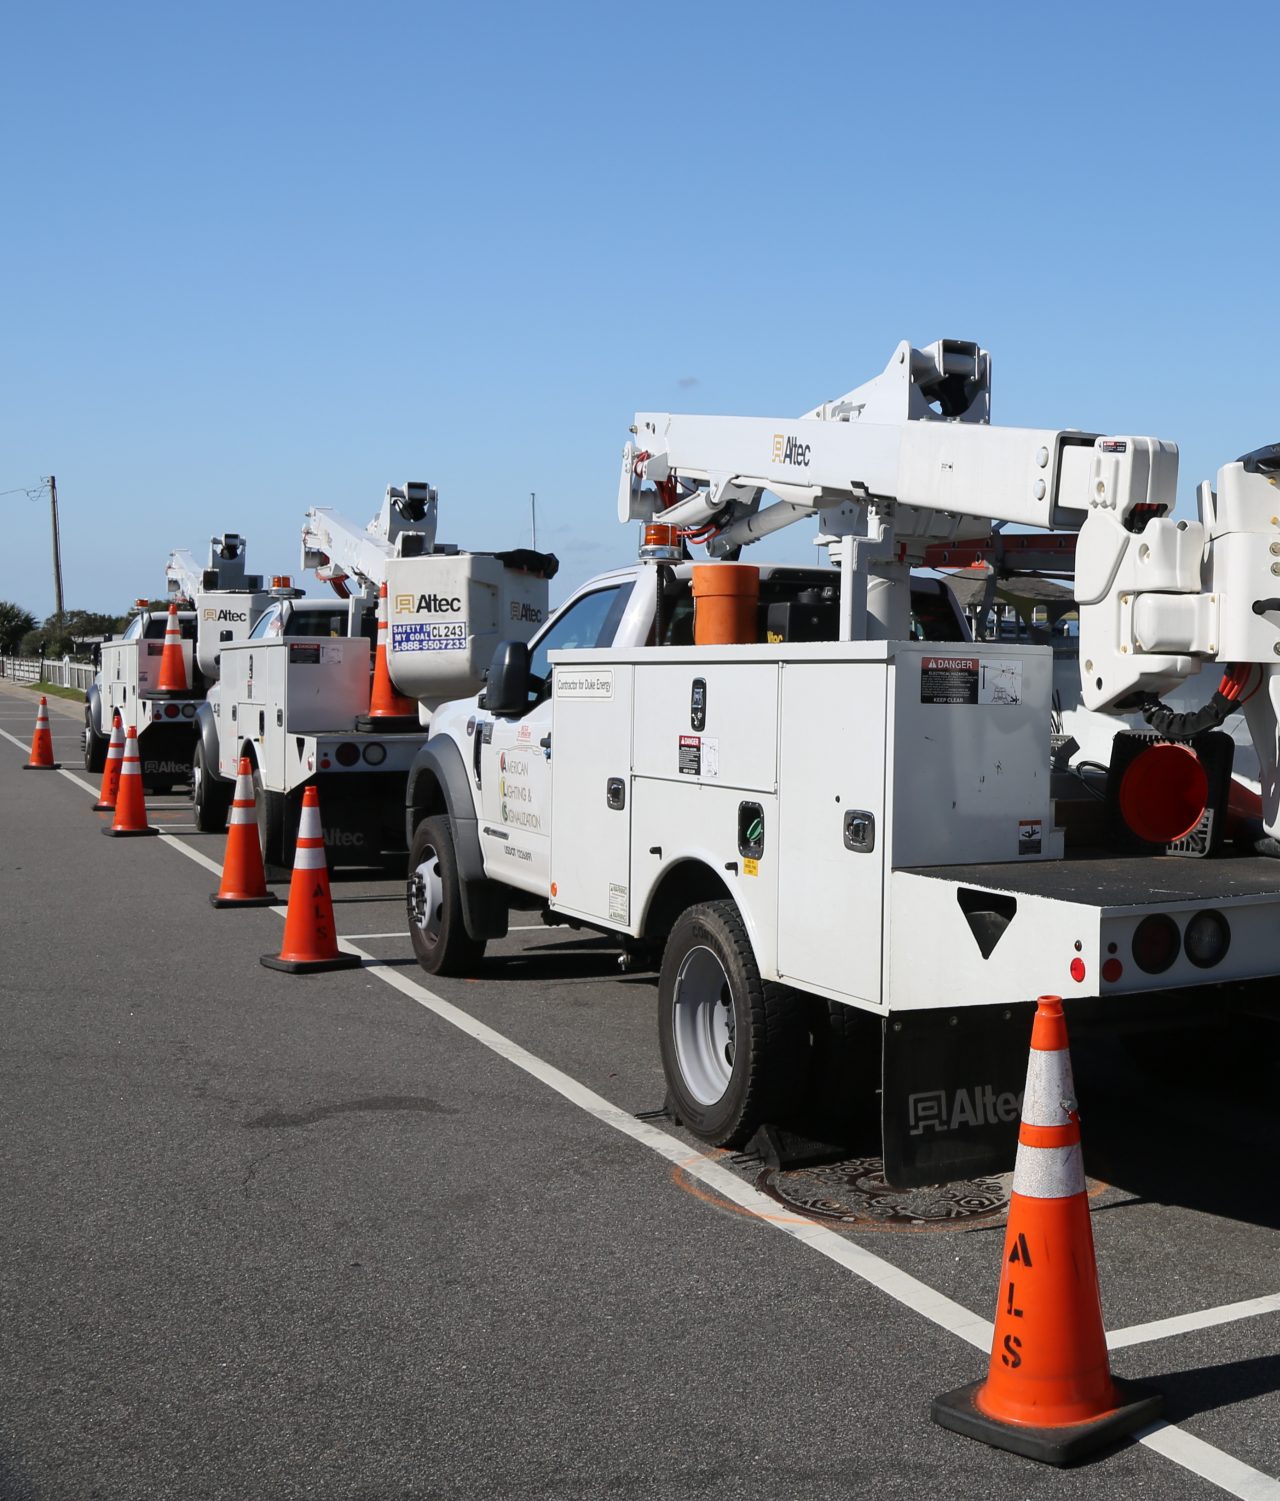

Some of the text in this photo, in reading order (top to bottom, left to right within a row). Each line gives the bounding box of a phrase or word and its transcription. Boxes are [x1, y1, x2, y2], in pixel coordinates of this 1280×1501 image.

[783, 436, 811, 467] Altec
[416, 594, 461, 613] Altec
[518, 603, 542, 623] Altec
[217, 609, 247, 622] Altec
[393, 625, 420, 633] SAFETY
[393, 640, 466, 651] 1-888-550-7233
[938, 660, 973, 669] DANGER
[557, 679, 577, 690] Contractor
[585, 679, 596, 690] Duke
[597, 678, 611, 692] Energy
[159, 760, 191, 773] Altec
[501, 754, 529, 777] AMERICAN
[312, 884, 328, 939] ALS
[950, 1084, 1025, 1129] Alte
[1002, 1232, 1032, 1368] ALS
